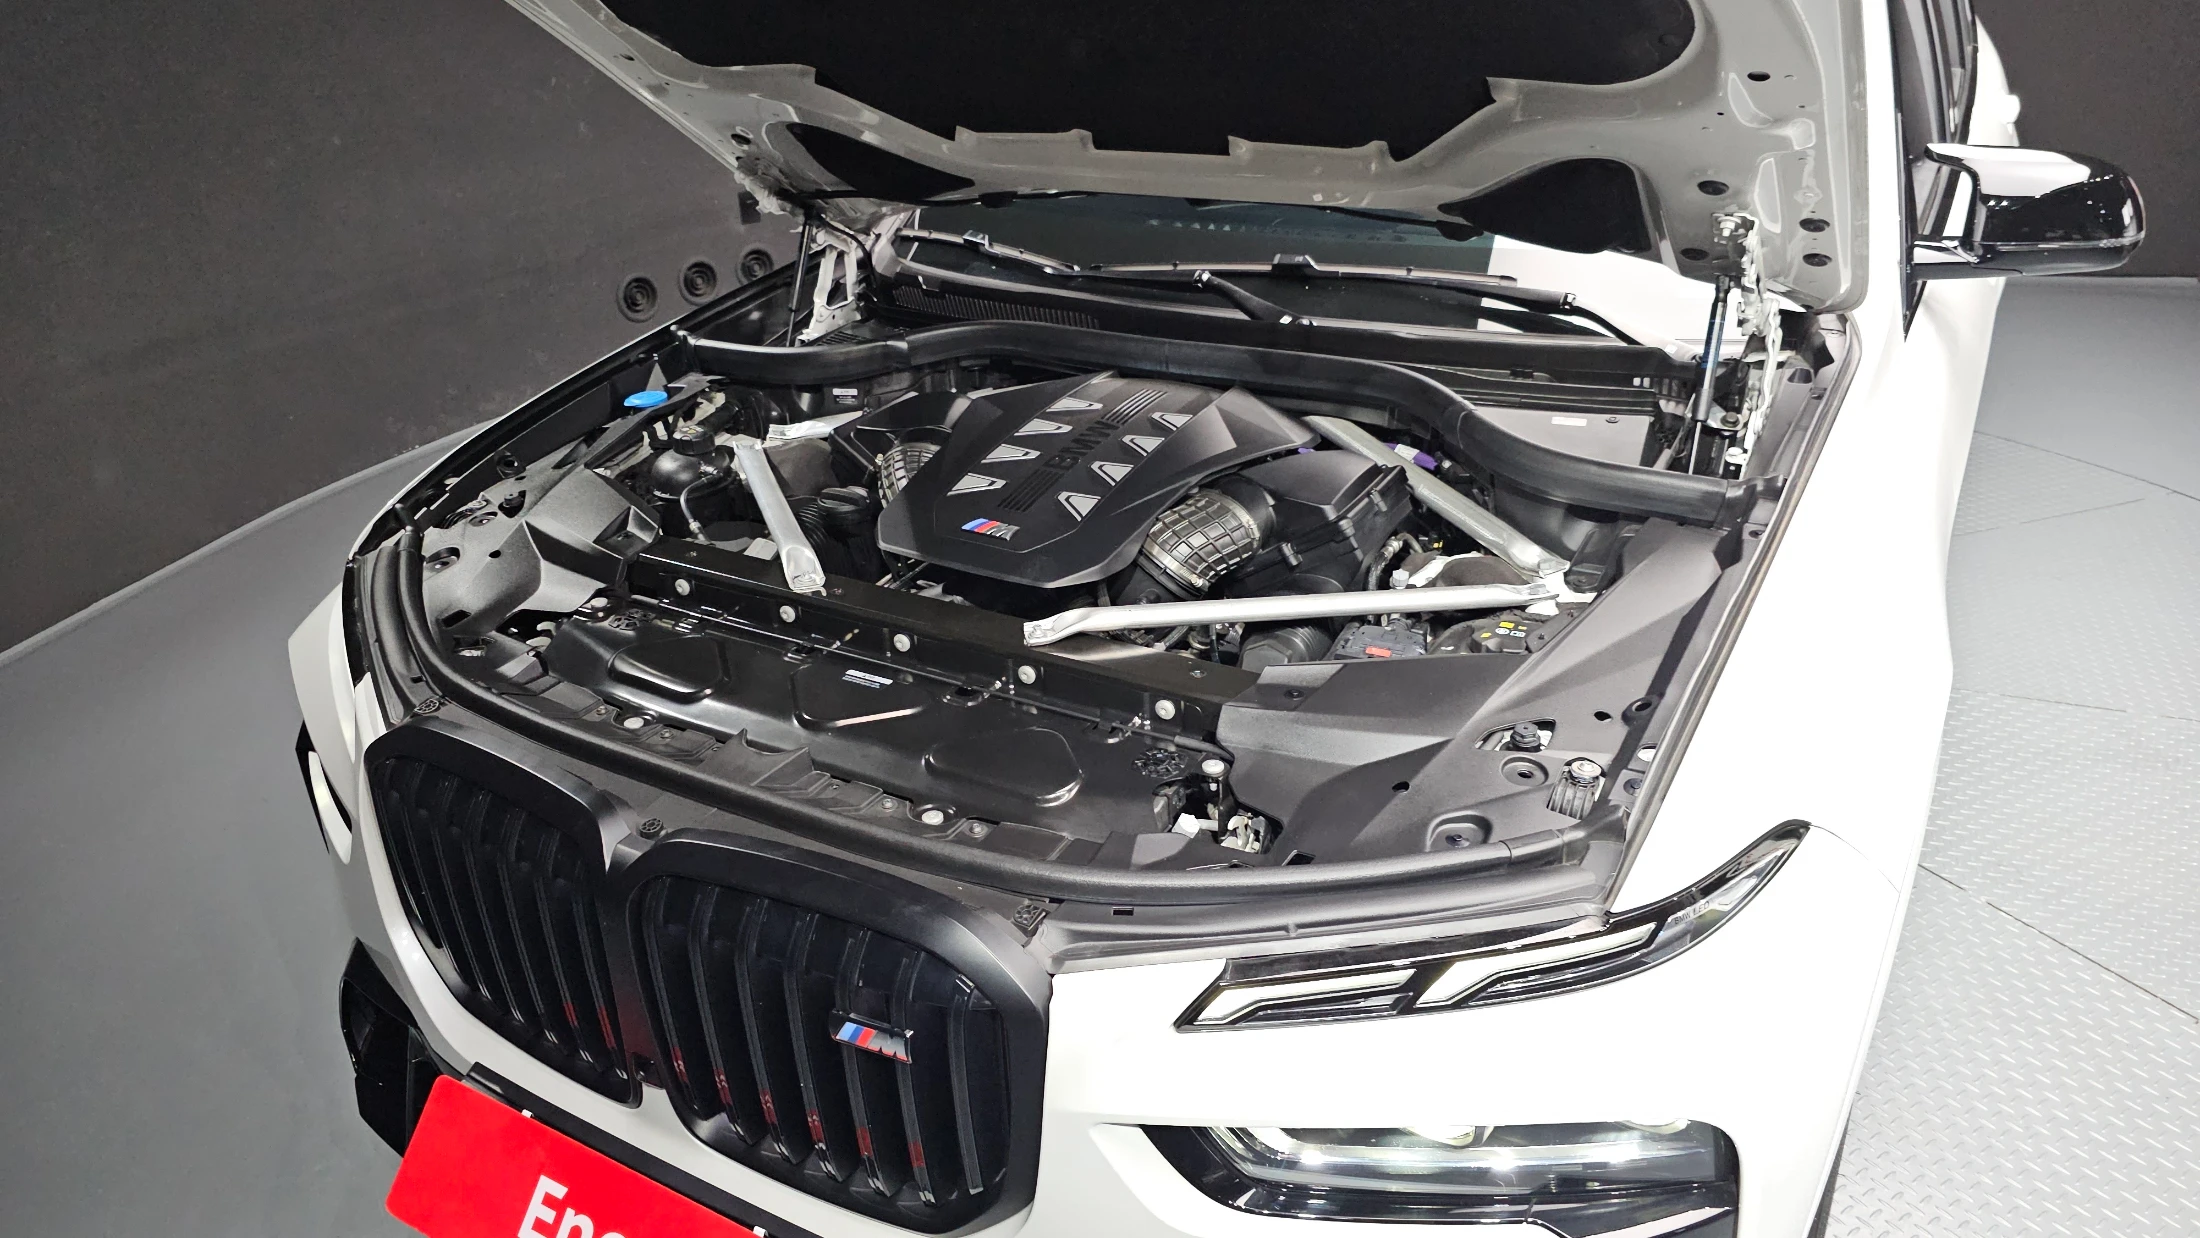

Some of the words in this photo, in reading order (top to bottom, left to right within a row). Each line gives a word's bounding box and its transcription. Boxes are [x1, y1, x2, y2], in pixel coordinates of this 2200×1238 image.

[1041, 420, 1120, 470] BMW
[866, 1029, 908, 1061] M
[517, 1174, 626, 1238] En
